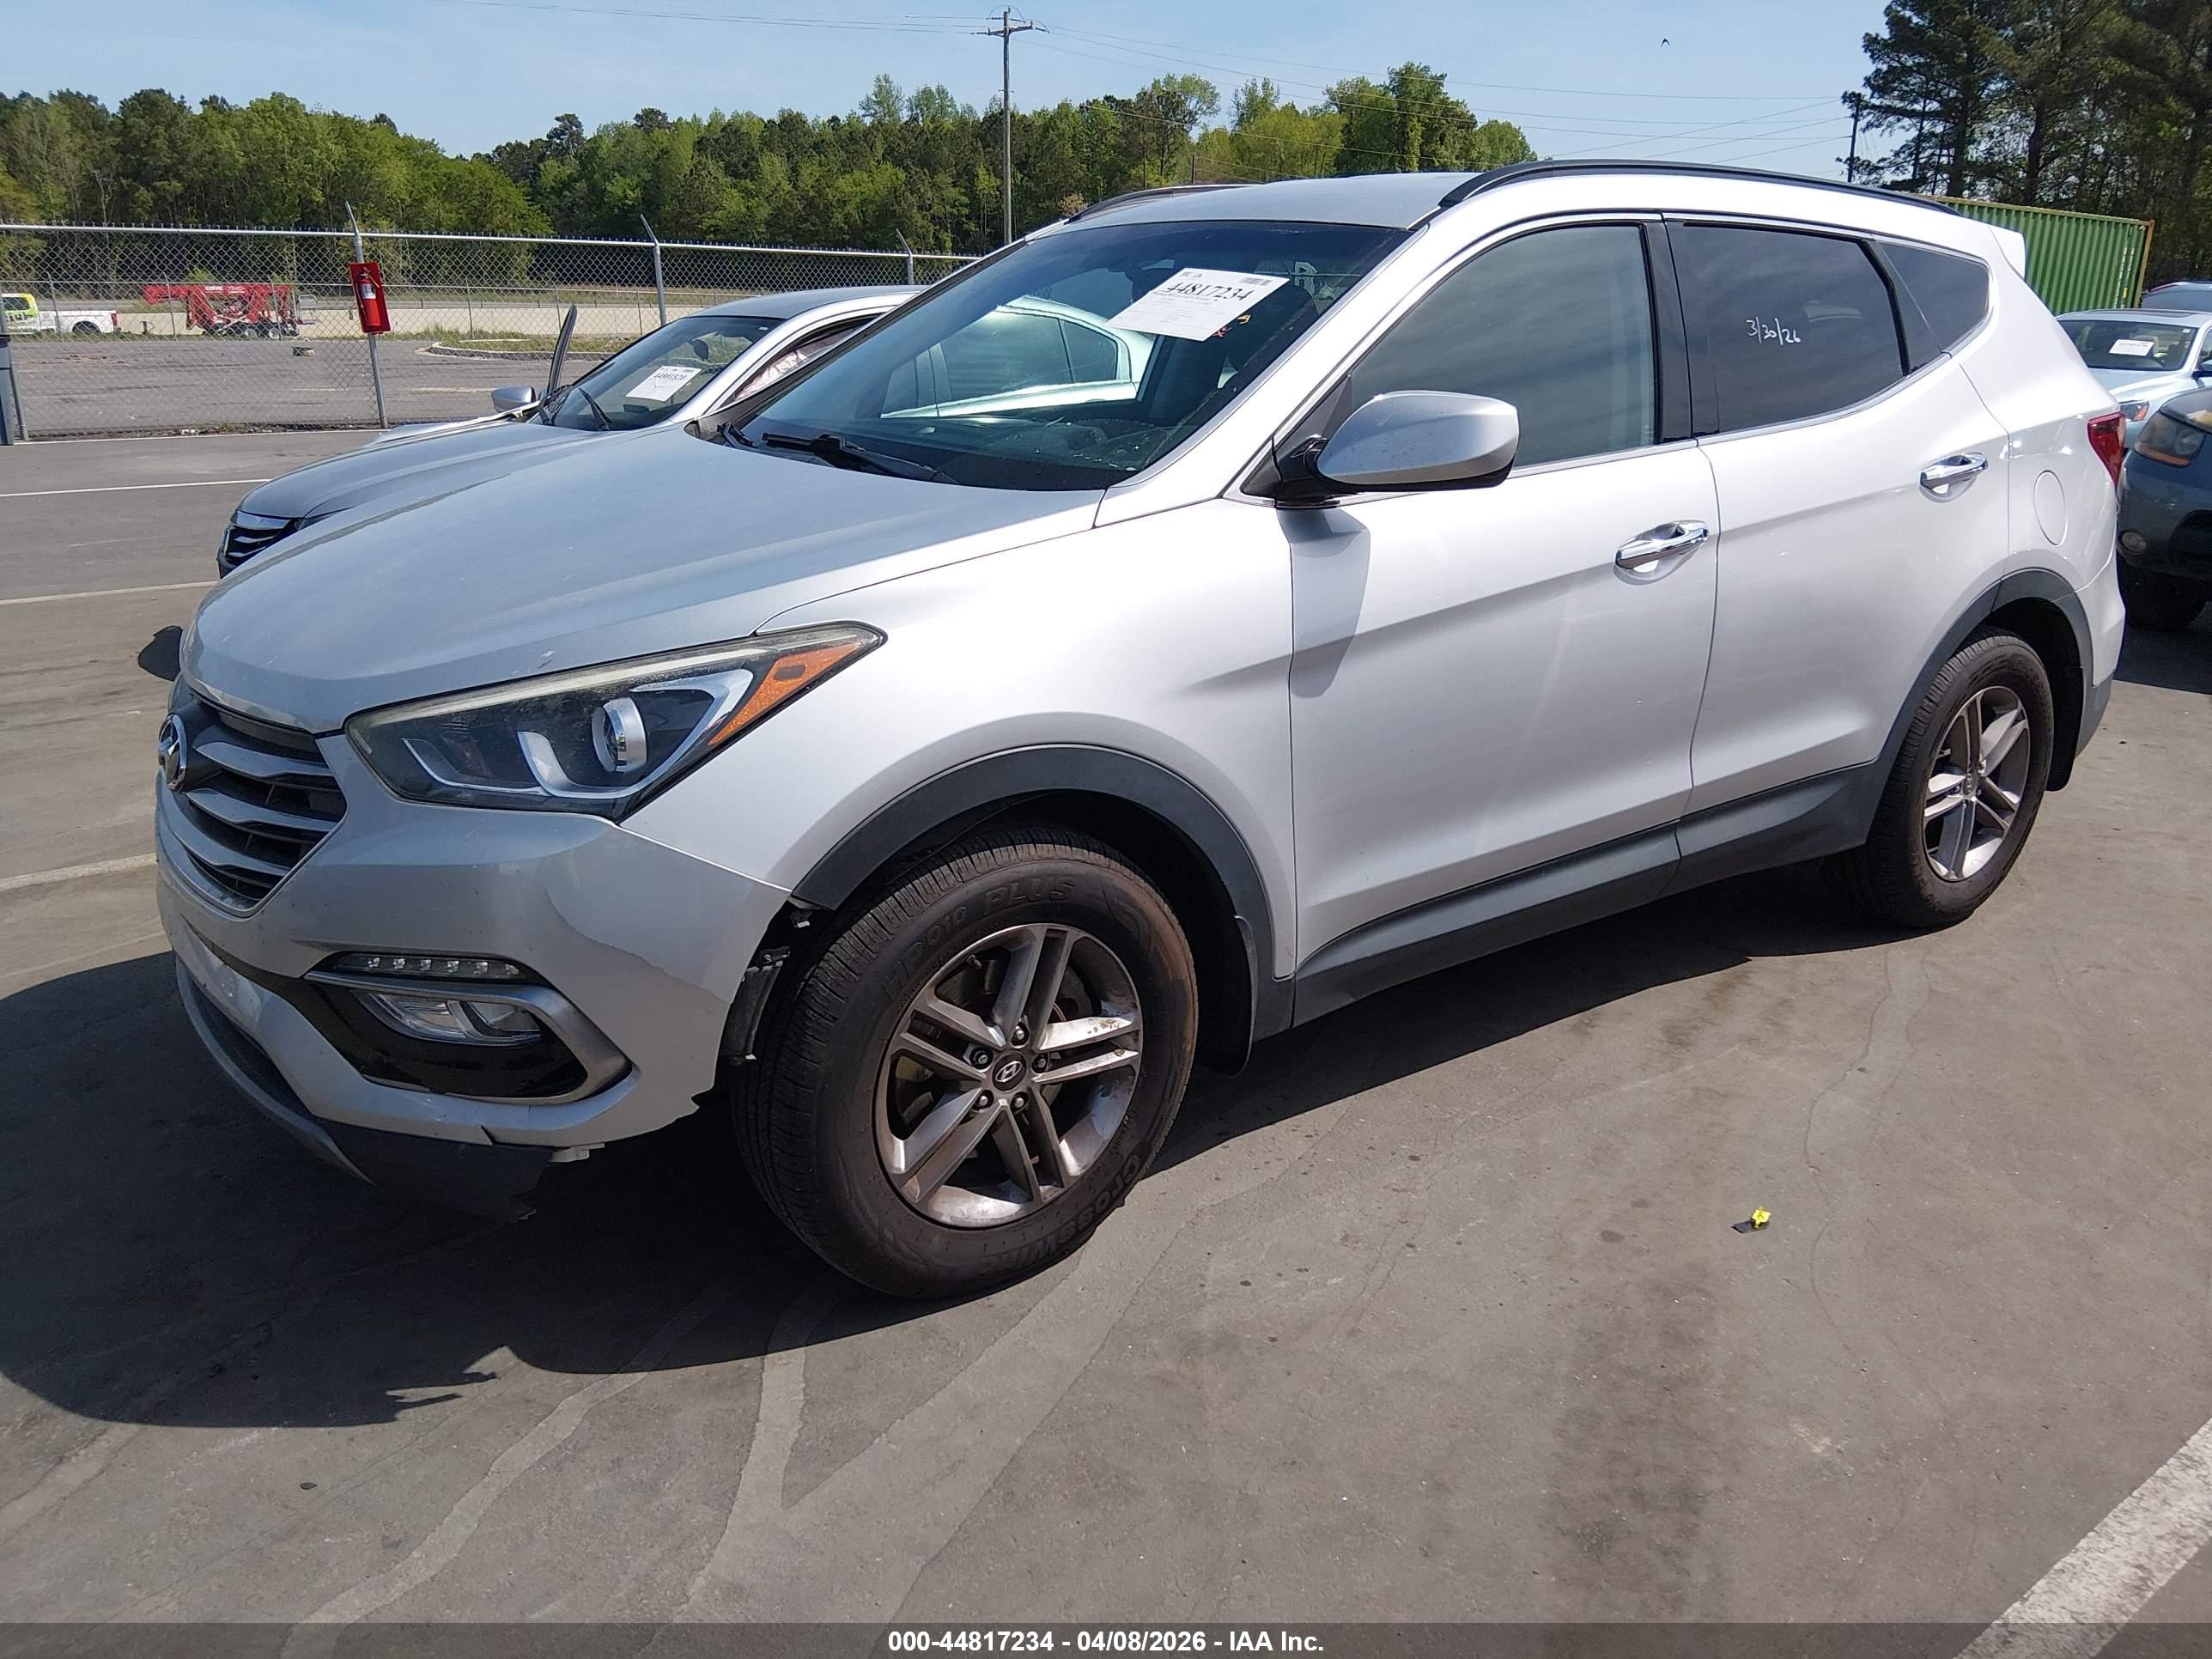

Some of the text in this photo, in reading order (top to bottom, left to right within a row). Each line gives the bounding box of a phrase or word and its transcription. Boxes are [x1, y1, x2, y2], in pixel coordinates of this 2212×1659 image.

[1166, 282, 1255, 301] 44817234
[1745, 315, 1802, 346] 3/30/26
[985, 876, 1075, 917] PLUS
